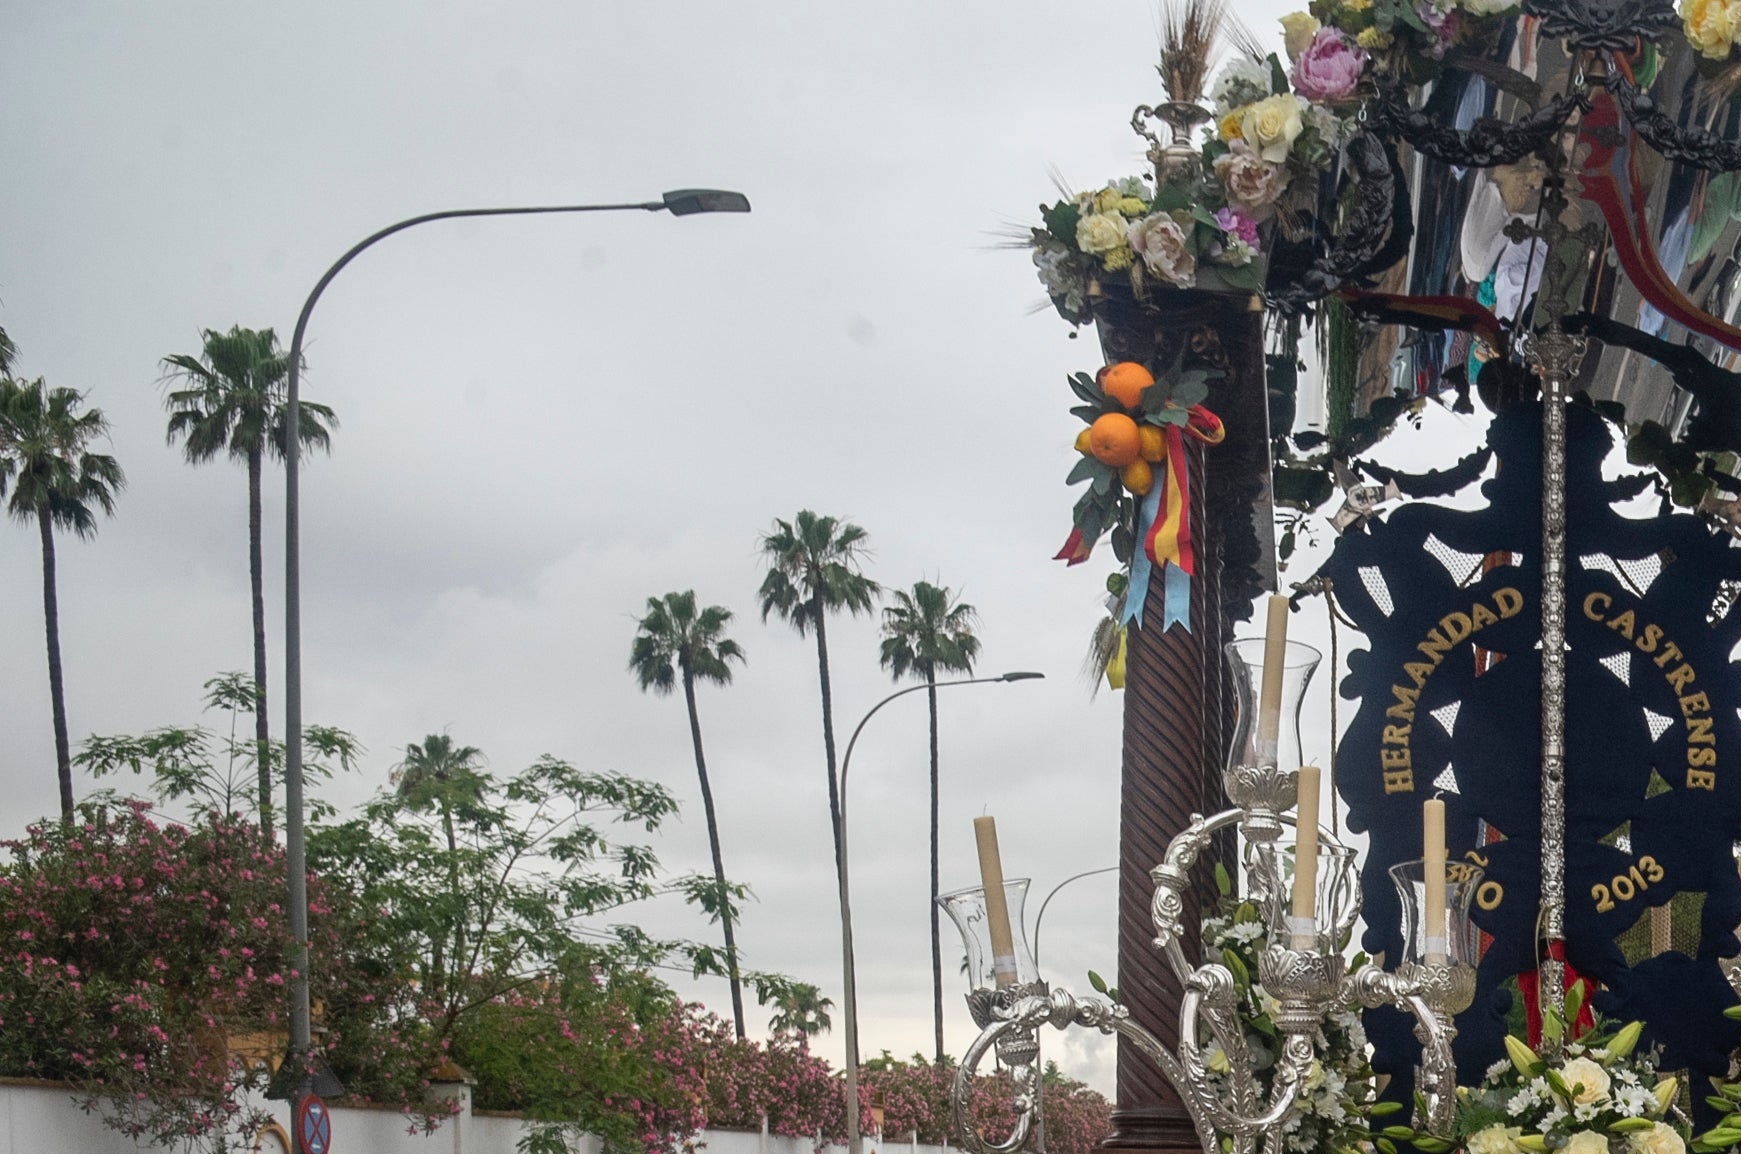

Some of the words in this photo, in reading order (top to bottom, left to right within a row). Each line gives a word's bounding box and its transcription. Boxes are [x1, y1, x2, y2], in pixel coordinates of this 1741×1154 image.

[1380, 586, 1525, 796] HERMANDAD
[1582, 591, 1718, 793] CASTRENSE
[1591, 854, 1665, 914] 2013
